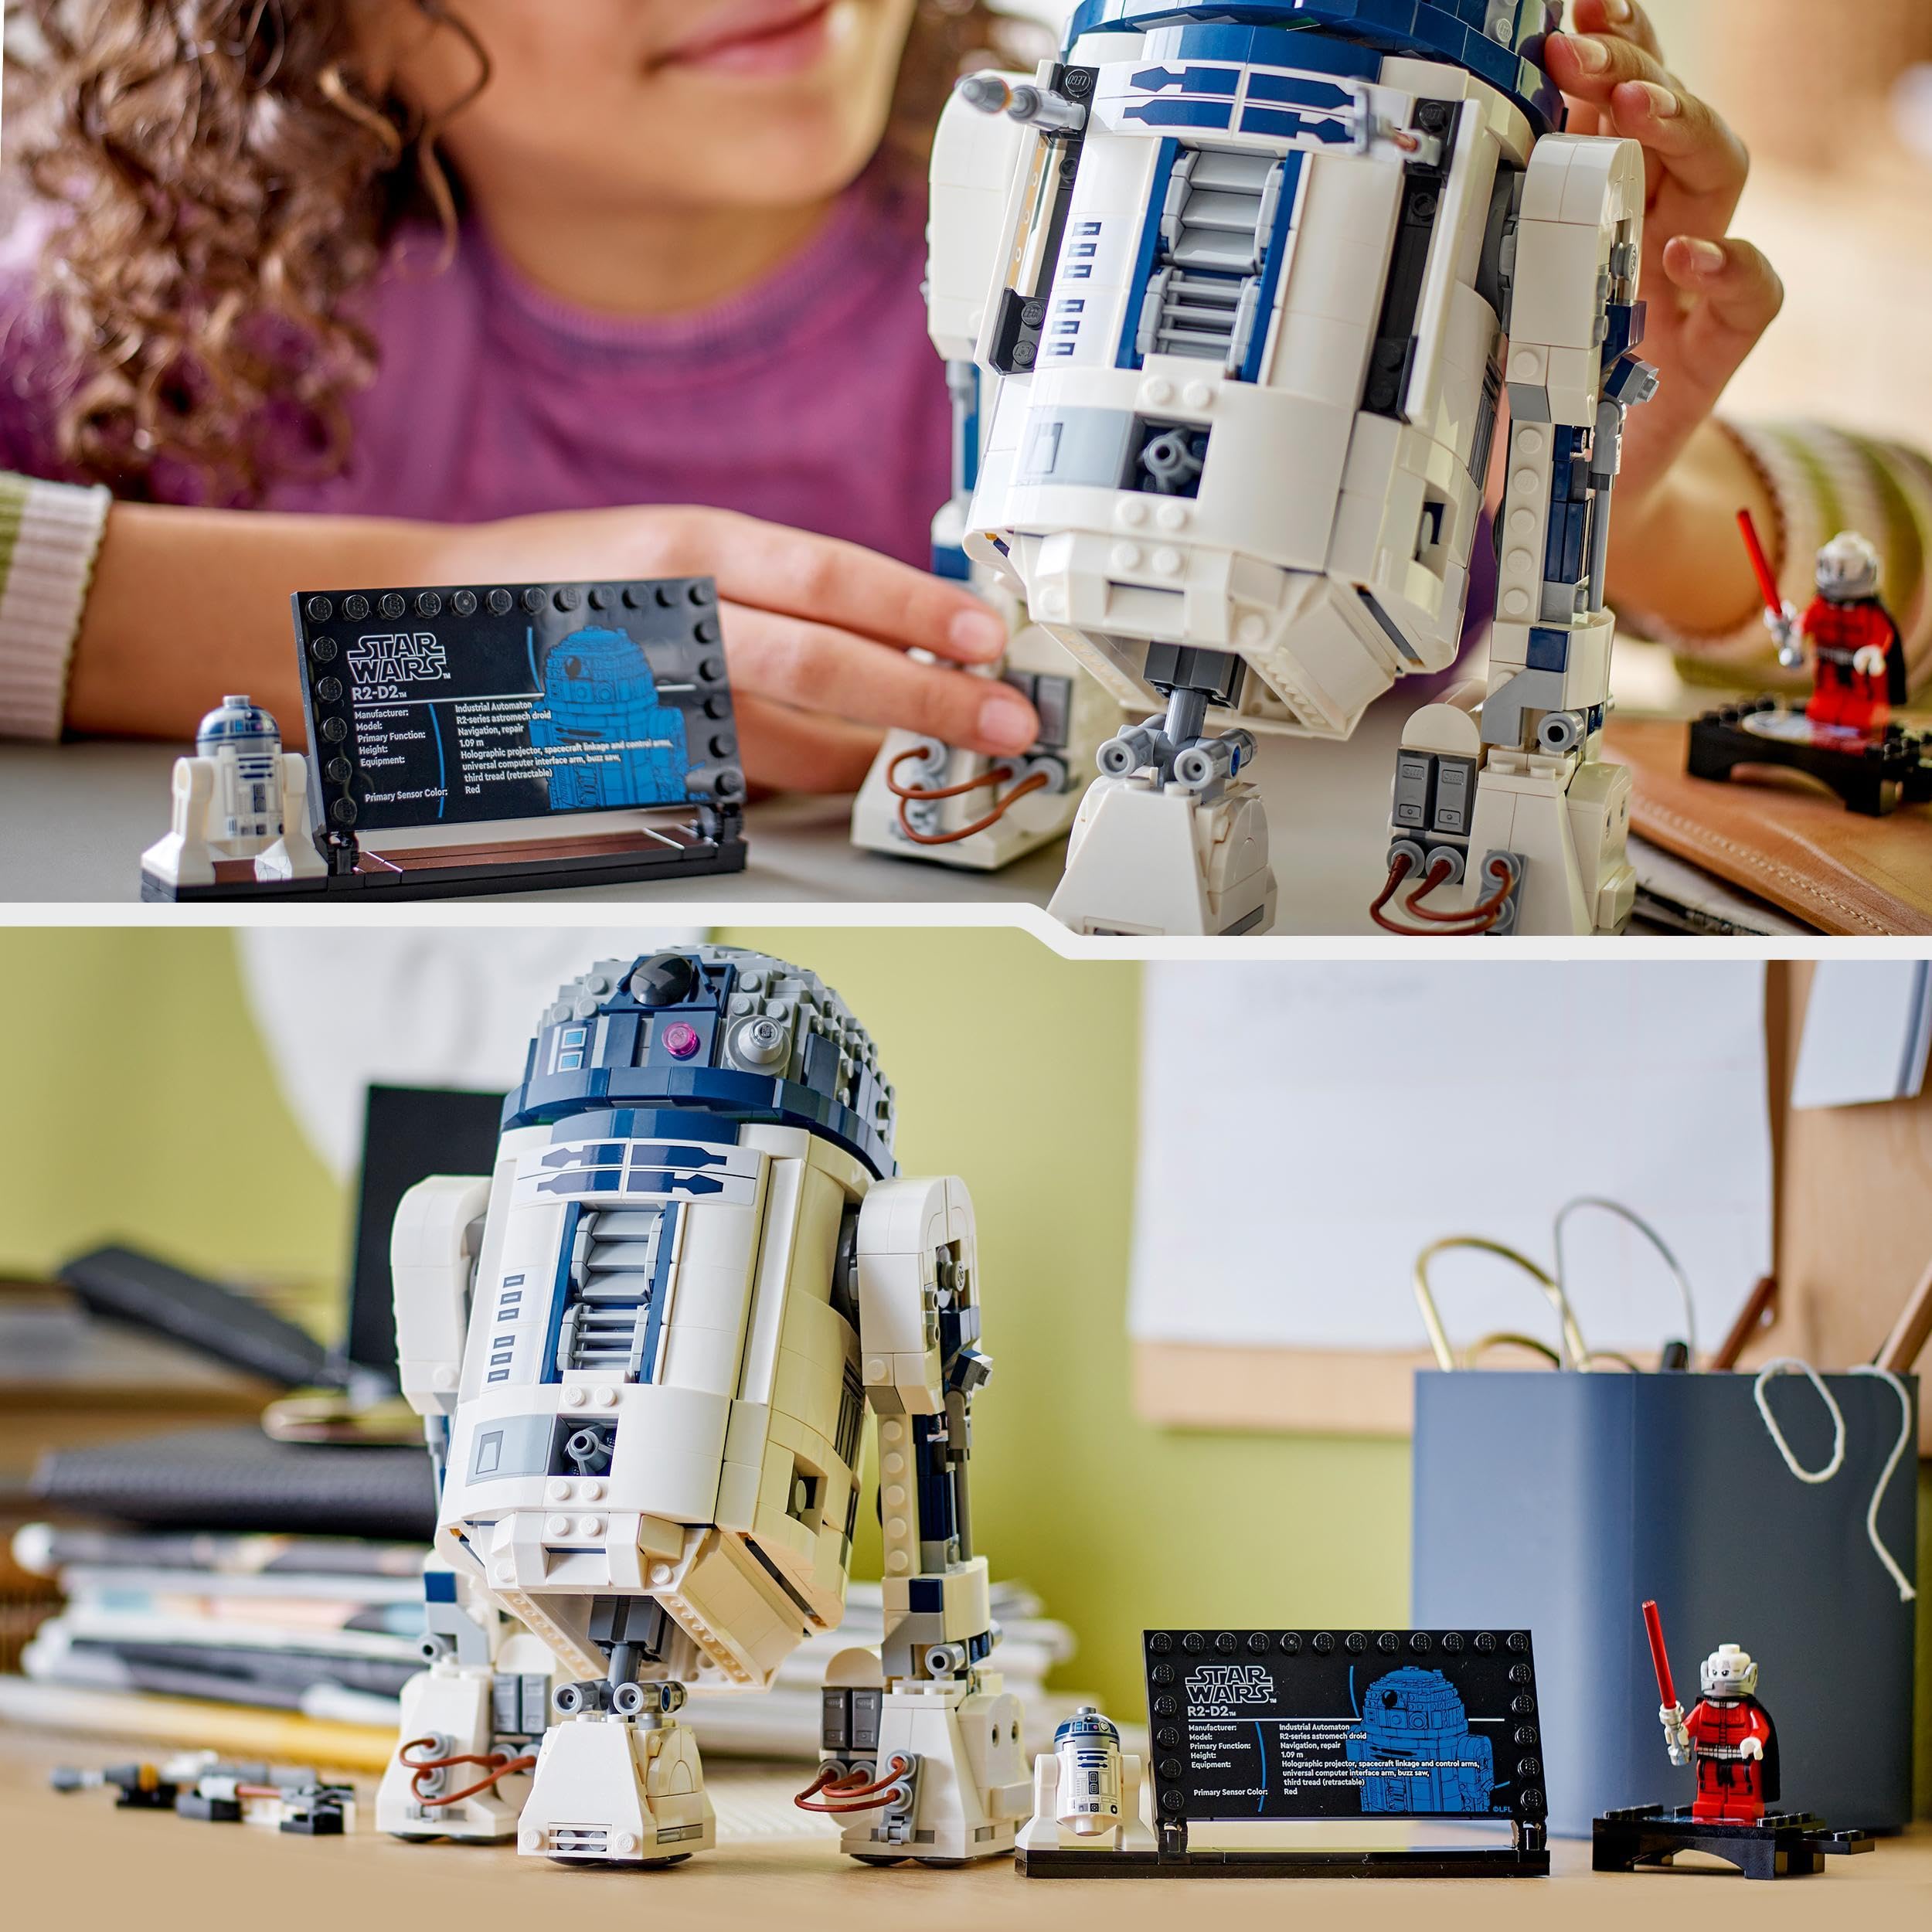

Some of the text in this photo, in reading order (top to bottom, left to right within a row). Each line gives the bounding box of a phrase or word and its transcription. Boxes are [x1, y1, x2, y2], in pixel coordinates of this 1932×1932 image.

[347, 632, 445, 660] STAR
[454, 702, 532, 713] Industrial Automaton
[355, 709, 409, 720] Manufacturer:
[456, 710, 552, 725] R2-series astromech droid
[355, 720, 383, 732] Model:
[457, 723, 524, 737] Navigation, repair
[357, 730, 426, 743] Primary Function:
[459, 739, 475, 748] 1.09
[359, 745, 388, 757] Height:
[461, 748, 506, 760] Holographic
[506, 747, 543, 758] projector,
[544, 742, 583, 755] spacecraft
[583, 742, 610, 752] linkage
[611, 740, 625, 749] and
[360, 756, 406, 768] Equipment:
[462, 760, 497, 771] universal
[498, 759, 534, 770] computer
[535, 756, 568, 767] interface
[569, 756, 586, 764] arm,
[587, 754, 604, 763] buzz
[464, 768, 553, 782] third tread (retractable)
[464, 784, 481, 794] Red
[365, 788, 448, 803] Primary Sensor Color:
[1185, 1665, 1273, 1685] STAR
[1280, 1741, 1341, 1750] Navigation, repair
[1191, 1761, 1232, 1770] Equipment:
[1281, 1760, 1323, 1768] Holographic
[1324, 1760, 1357, 1768] projector,
[1358, 1760, 1395, 1768] spacecraft
[1395, 1760, 1420, 1768] linkage
[1322, 1778, 1366, 1787] (retractable)
